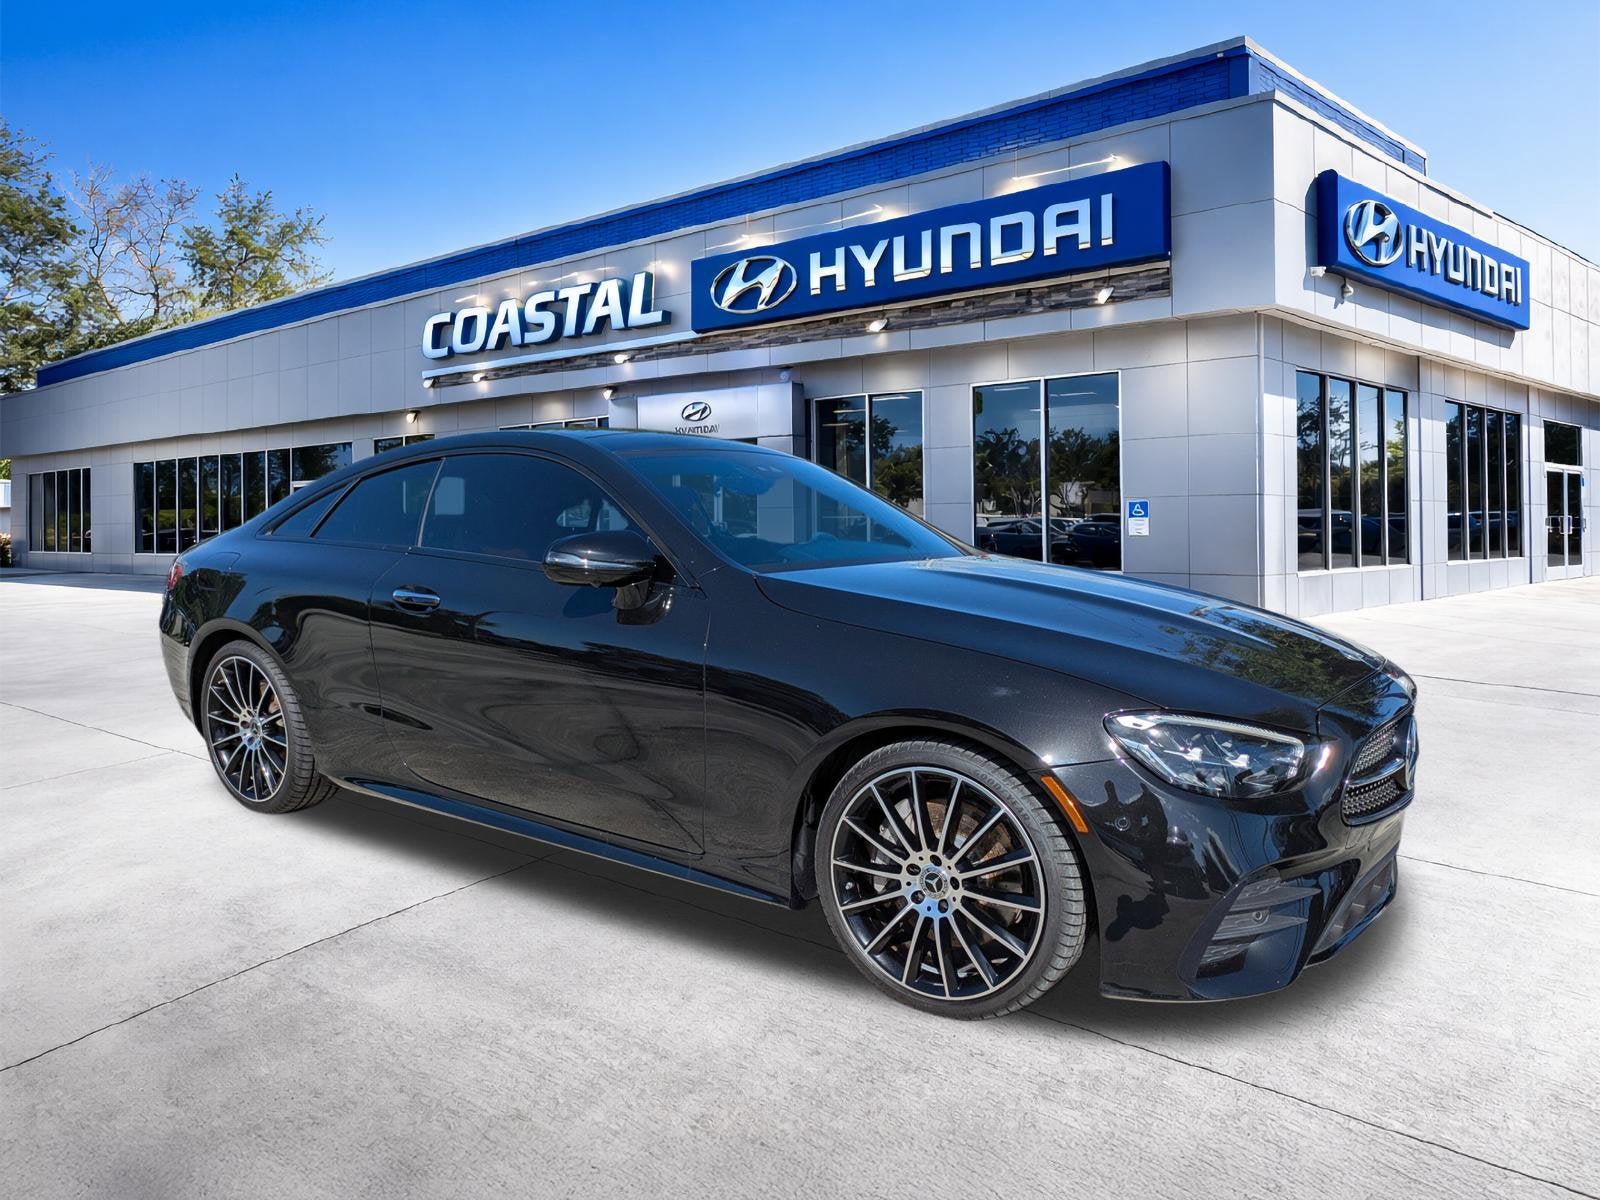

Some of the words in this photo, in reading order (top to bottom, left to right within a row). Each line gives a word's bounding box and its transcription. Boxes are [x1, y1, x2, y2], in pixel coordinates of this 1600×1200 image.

[809, 192, 1113, 296] HYUNDAI
[1406, 224, 1522, 306] HYUNDAI
[422, 271, 669, 359] COASTAL
